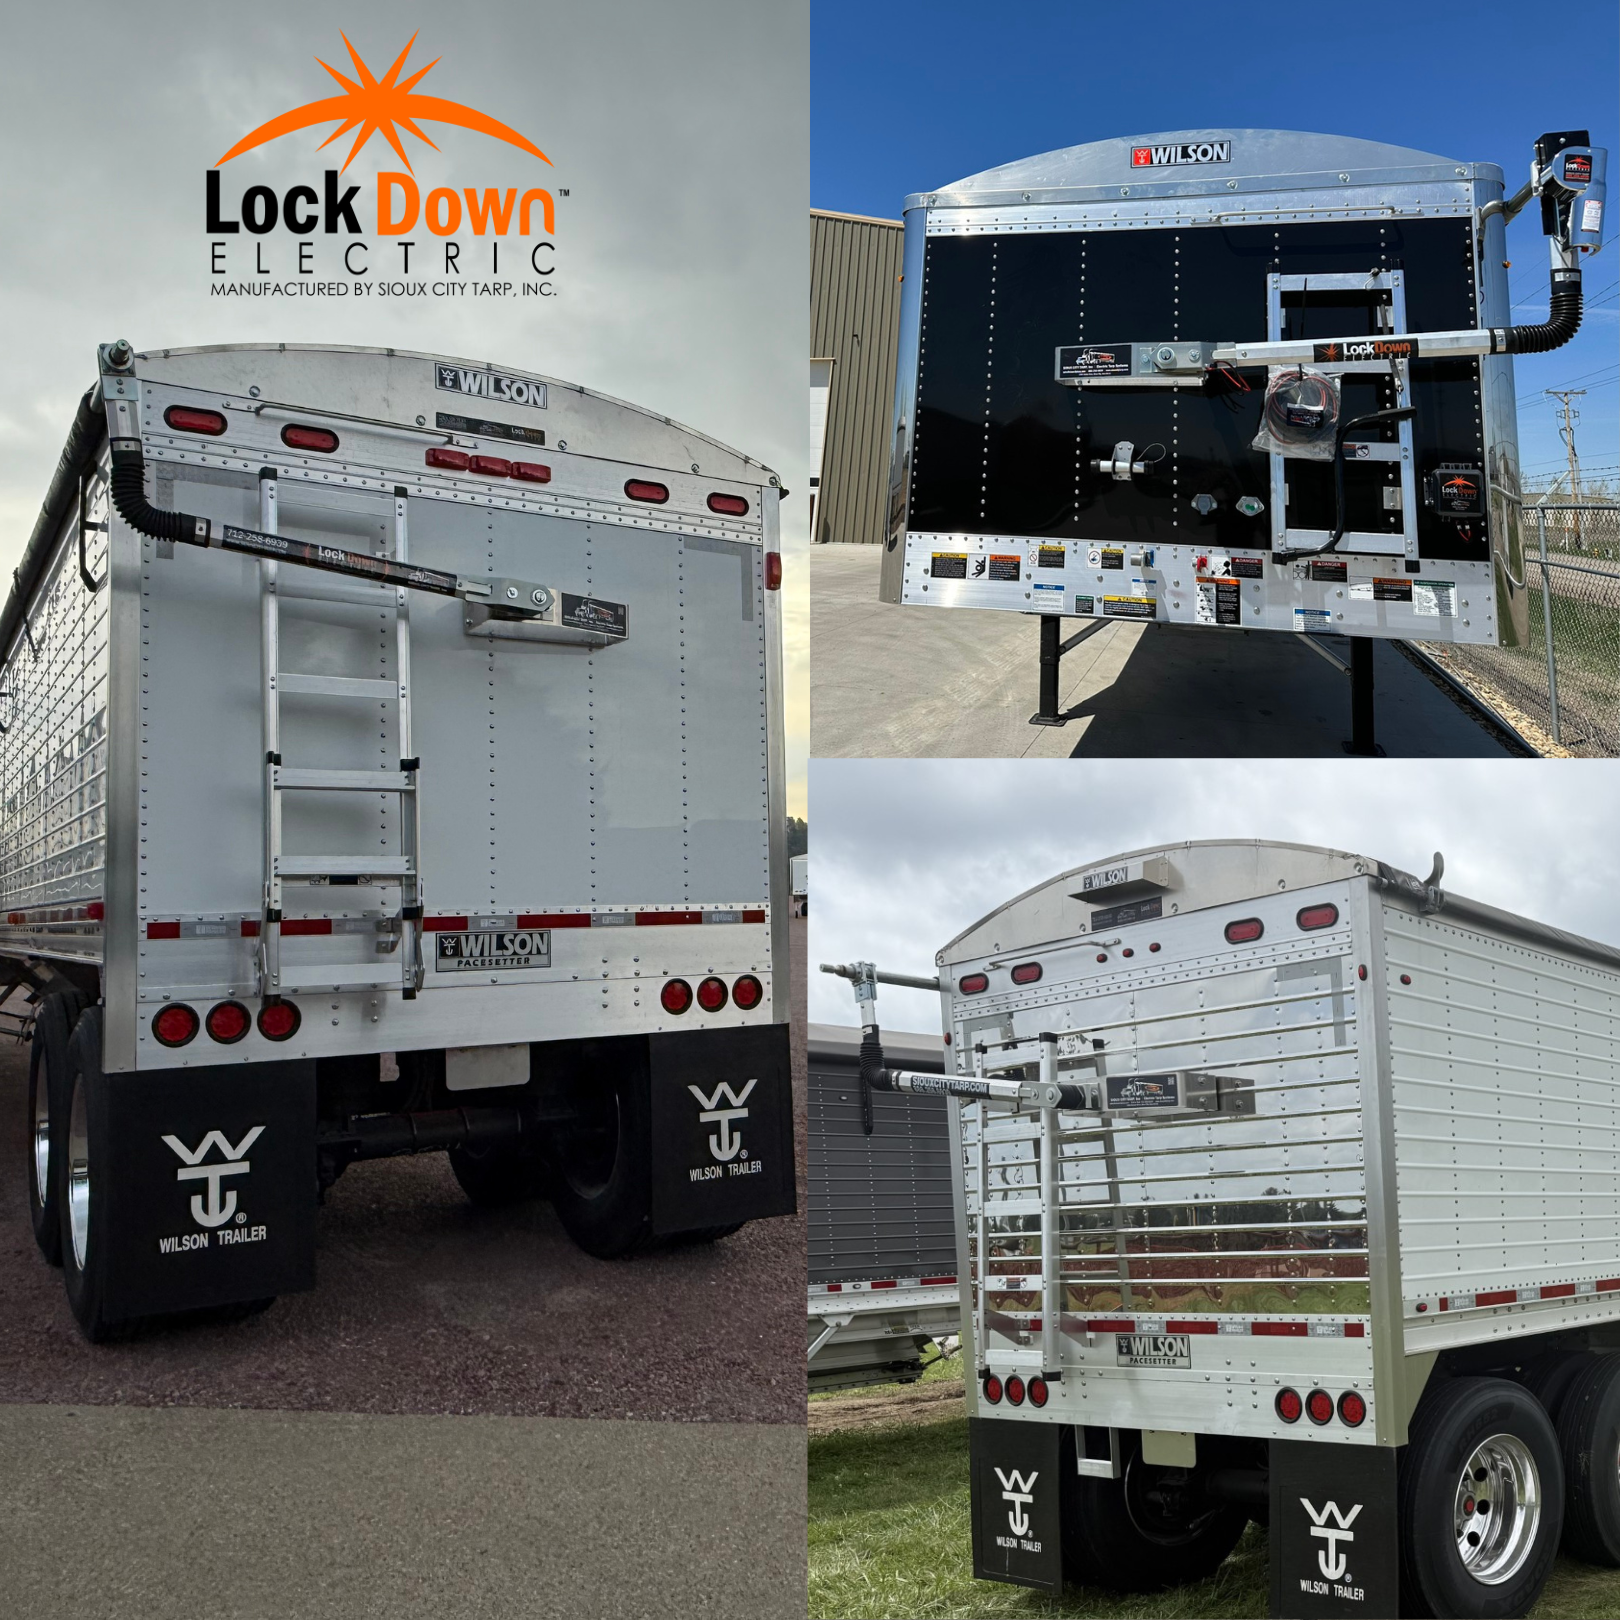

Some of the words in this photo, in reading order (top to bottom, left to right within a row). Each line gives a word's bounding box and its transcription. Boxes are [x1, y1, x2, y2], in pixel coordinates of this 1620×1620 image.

[1151, 143, 1228, 164] WILSON
[458, 371, 544, 406] WILSON
[318, 545, 345, 561] Lock
[1091, 867, 1127, 888] WILSON
[460, 932, 549, 957] WILSON
[457, 957, 530, 967] PACESETTER
[912, 1076, 987, 1093] SIOUXCITYTARP.COM
[689, 1165, 723, 1182] WILSON
[727, 1160, 762, 1176] TRAILER
[160, 1232, 209, 1253] WILSON
[217, 1225, 267, 1245] TRAILER
[1130, 1337, 1188, 1357] WILSON
[1129, 1357, 1177, 1365] PACESETTER
[996, 1535, 1018, 1549] WILSON
[1020, 1539, 1042, 1553] TRAILER
[1300, 1579, 1329, 1595] WILSON
[1333, 1584, 1365, 1601] TRAILER
